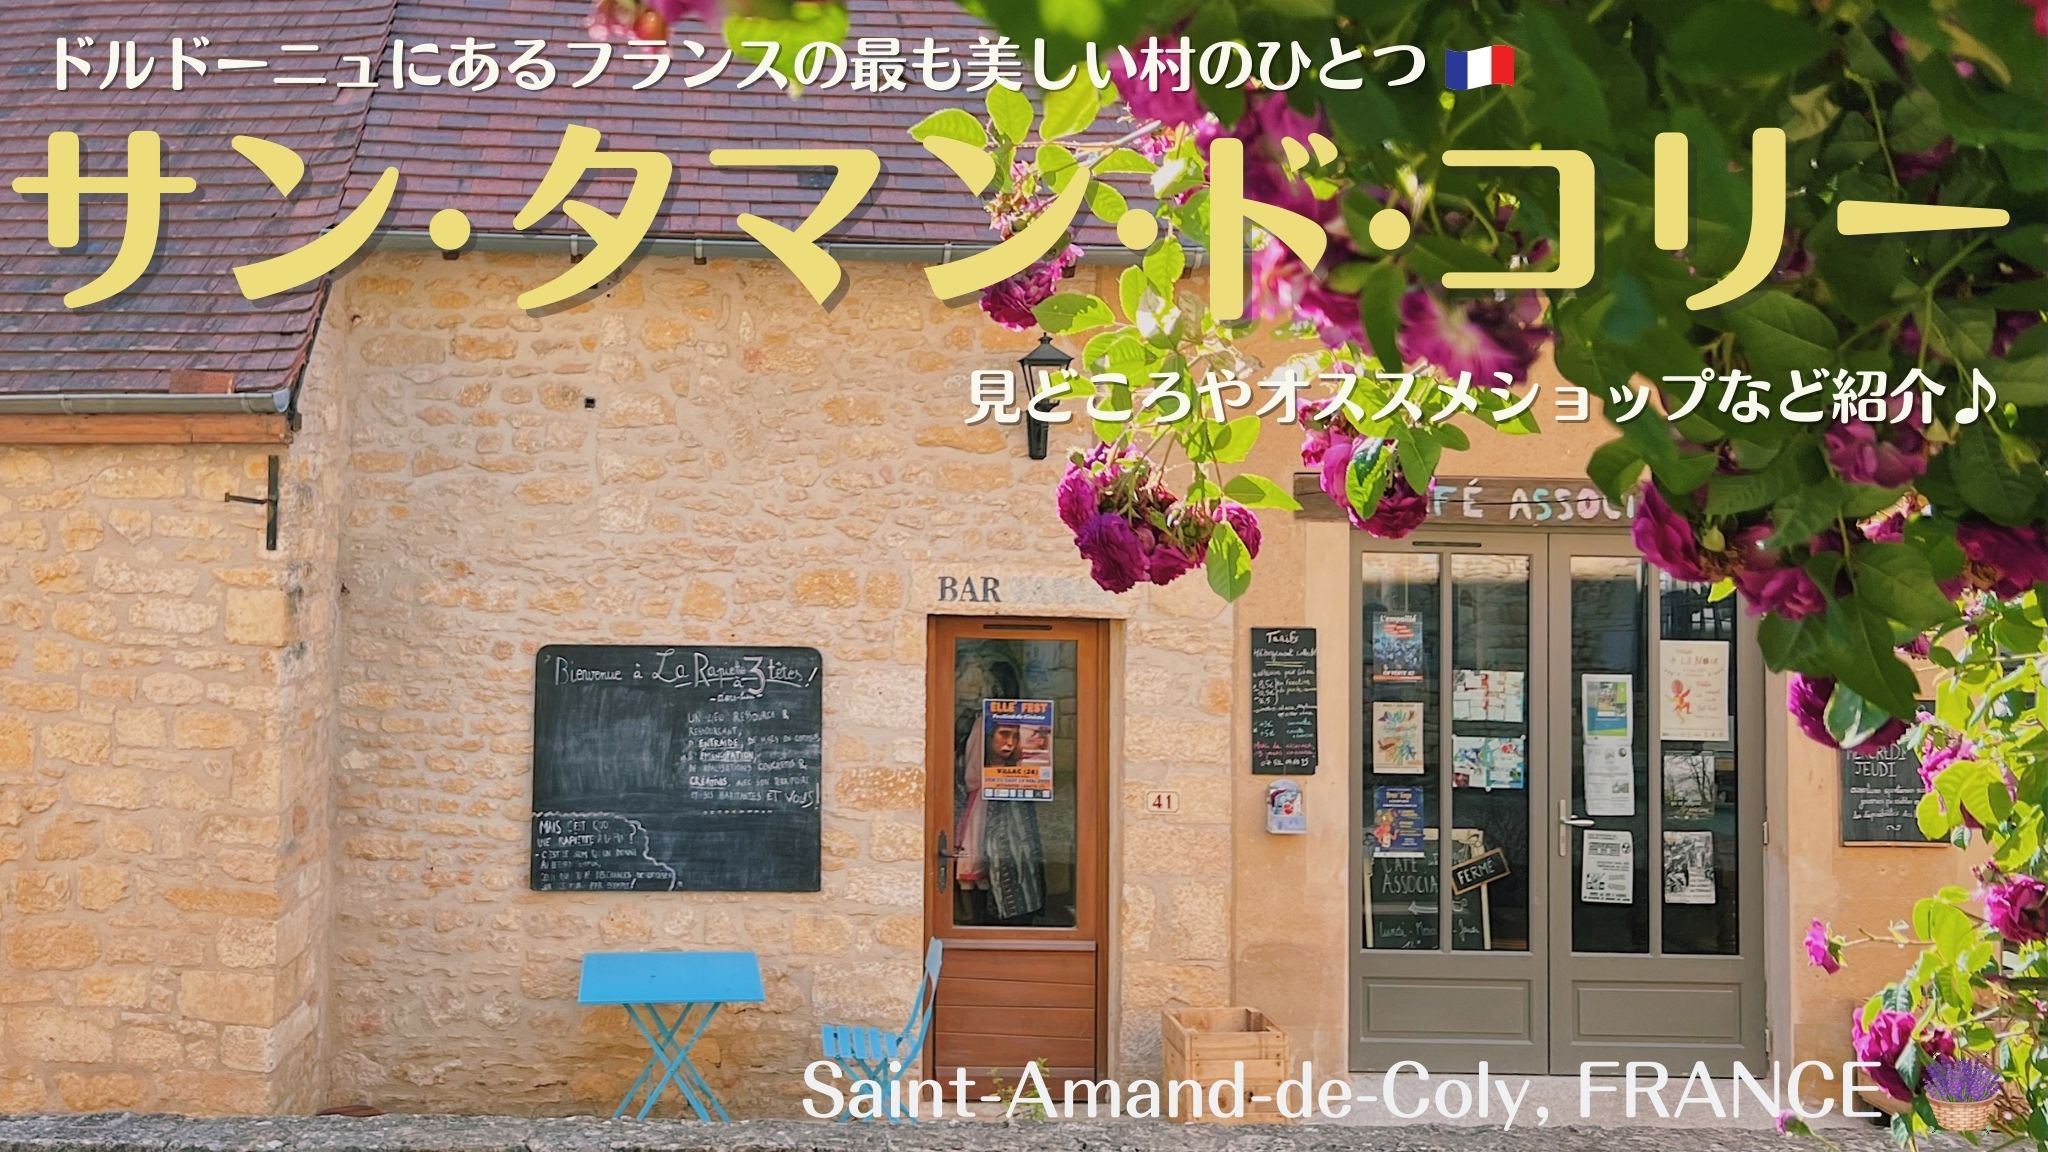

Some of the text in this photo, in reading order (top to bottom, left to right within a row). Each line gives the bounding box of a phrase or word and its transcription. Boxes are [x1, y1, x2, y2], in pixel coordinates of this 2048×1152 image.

[1426, 478, 1484, 519] FÉ
[938, 576, 1002, 602] BAR
[555, 656, 623, 685] Bienvenue
[633, 663, 644, 679] à
[652, 648, 690, 683] La
[743, 656, 765, 694] 3
[1854, 761, 1898, 777] JEUDI
[1152, 794, 1171, 809] 41
[1456, 857, 1496, 886] FERMÉ
